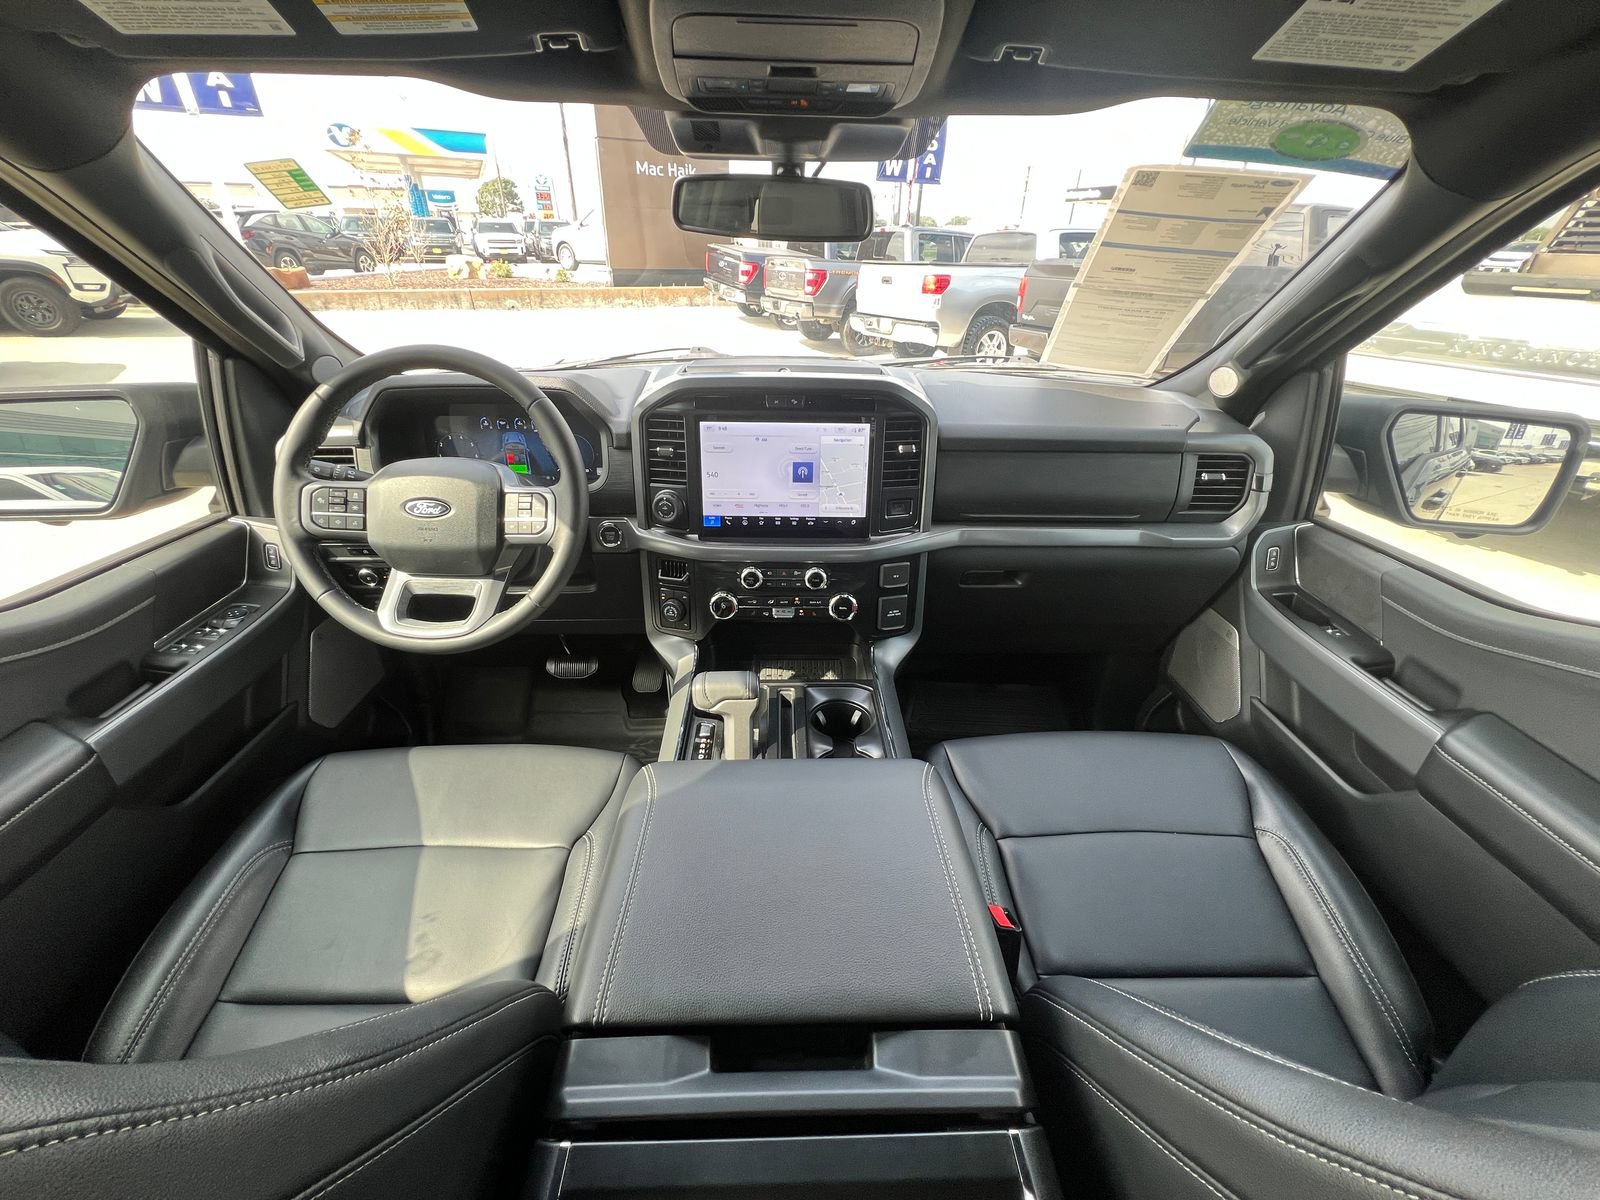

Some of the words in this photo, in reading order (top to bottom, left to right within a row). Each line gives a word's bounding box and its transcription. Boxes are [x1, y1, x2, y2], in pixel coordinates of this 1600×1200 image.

[635, 160, 664, 176] Mac
[667, 162, 697, 177] Haik
[706, 471, 719, 479] 540
[413, 502, 442, 514] Ford
